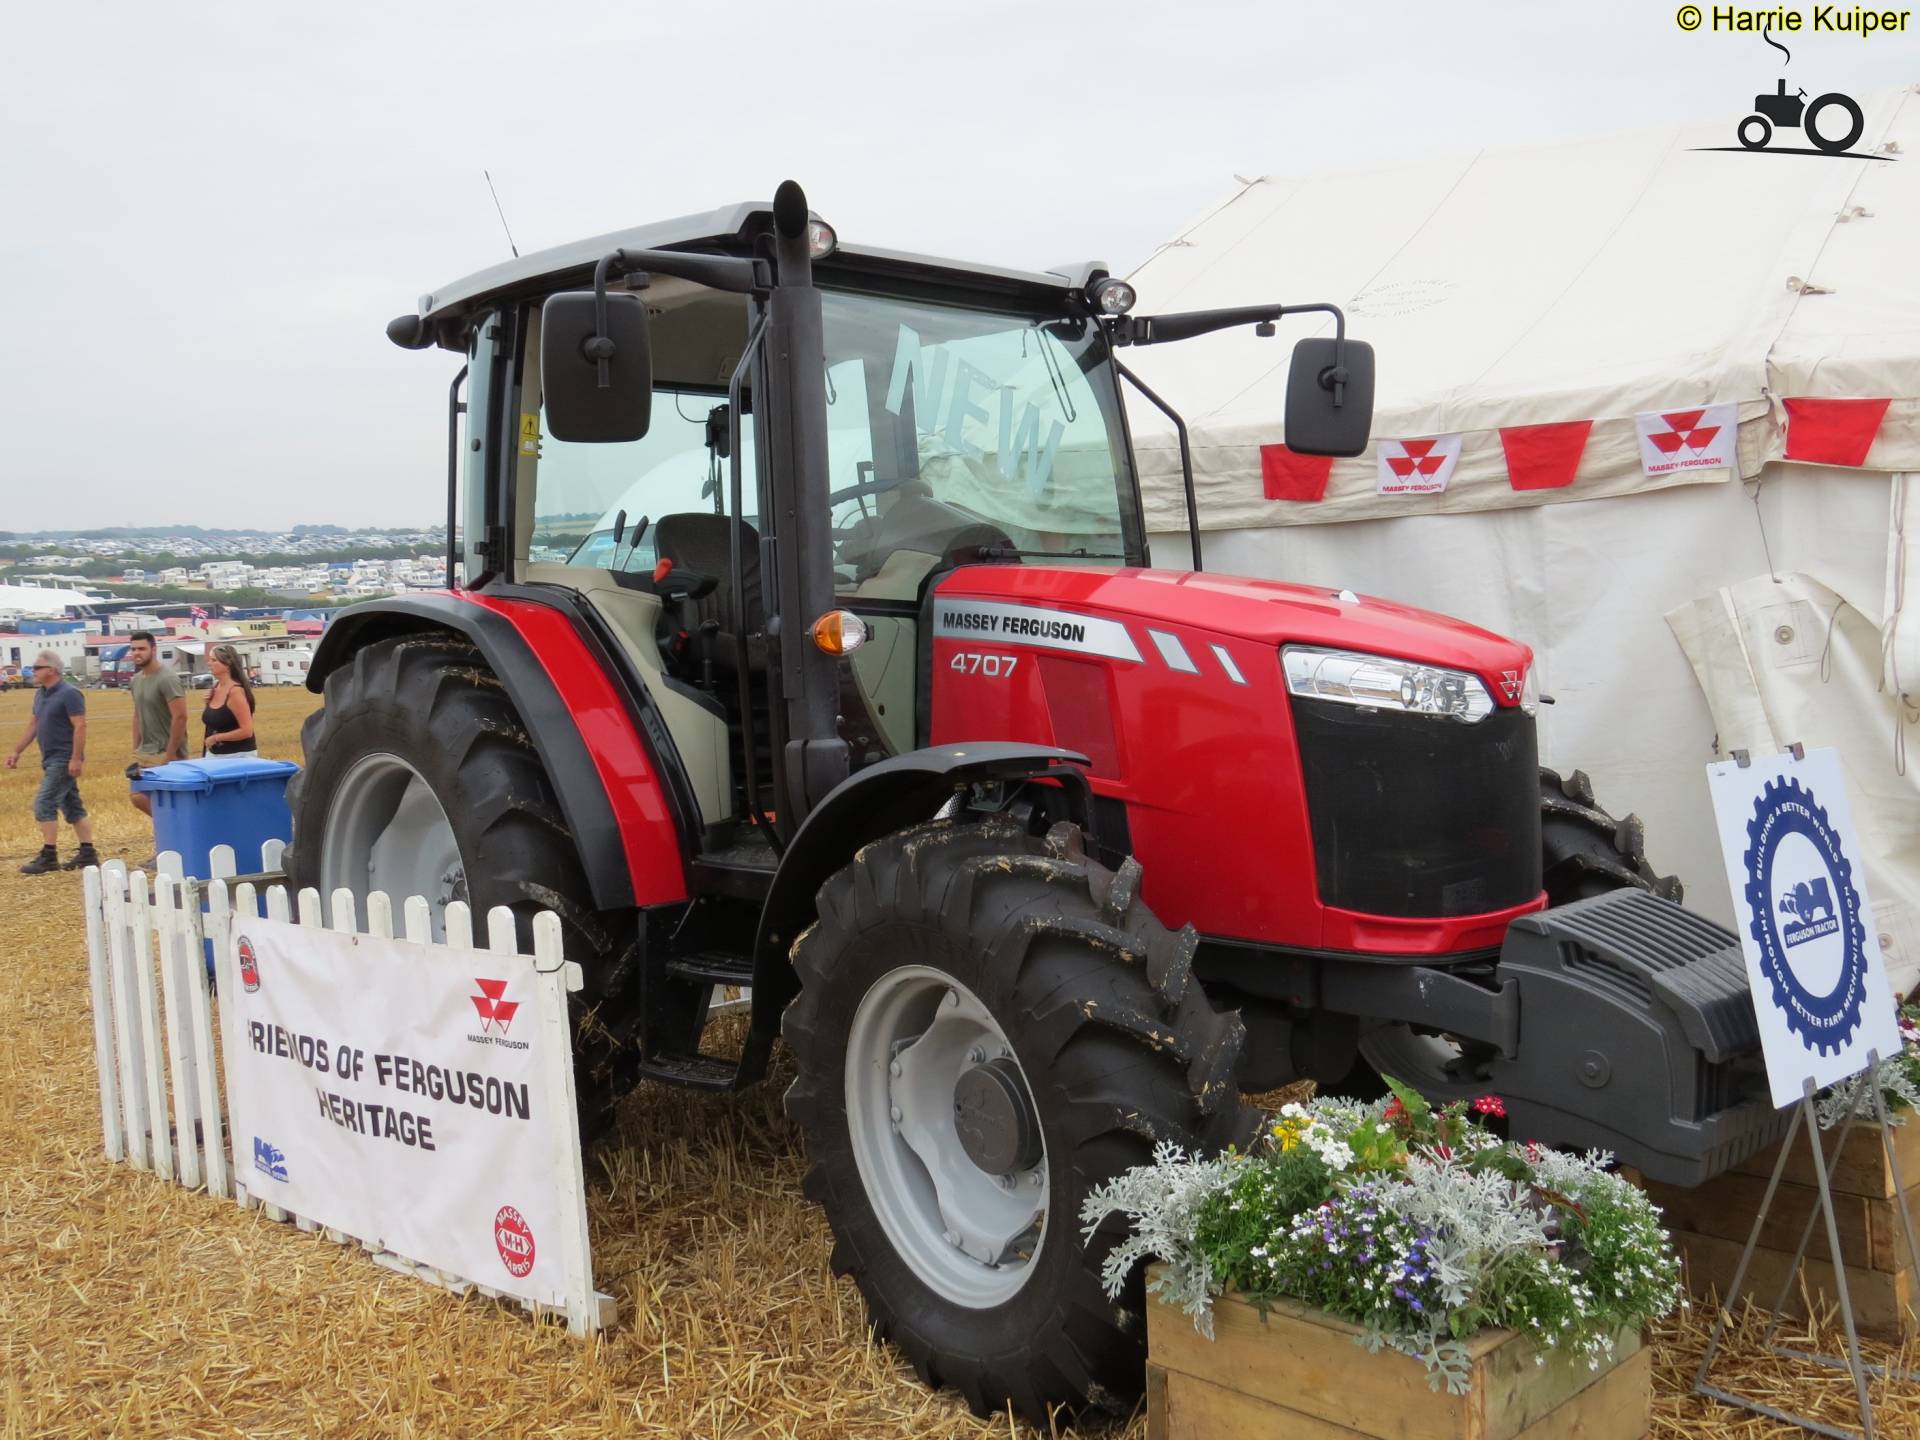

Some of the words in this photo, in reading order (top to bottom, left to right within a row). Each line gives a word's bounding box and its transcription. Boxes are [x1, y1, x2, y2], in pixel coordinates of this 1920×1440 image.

[885, 322, 1065, 501] NEW
[1647, 463, 1678, 473] MASSEY
[1680, 457, 1722, 467] FERGUSON
[943, 612, 998, 631] MASSEY
[1002, 616, 1085, 643] FERGUSON
[951, 652, 1018, 678] 4707
[1756, 813, 1775, 881] BUILDING
[1775, 806, 1782, 816] A
[1781, 802, 1810, 819] BETTER
[1812, 815, 1839, 863] WORLD
[1786, 926, 1816, 945] FERGUSON
[1814, 919, 1838, 935] TRACTOR
[1760, 907, 1789, 994] THROUGH
[1791, 995, 1822, 1028] BETTER
[1823, 1009, 1844, 1028] FARM
[467, 1034, 493, 1044] MASSEY
[495, 1037, 529, 1050] FERGUSON
[336, 1044, 364, 1082] OF
[374, 1054, 530, 1120] FERGUSON
[315, 1087, 436, 1151] HERITAGE
[497, 1208, 529, 1234] MASSEY
[502, 1251, 530, 1275] HARRIS
